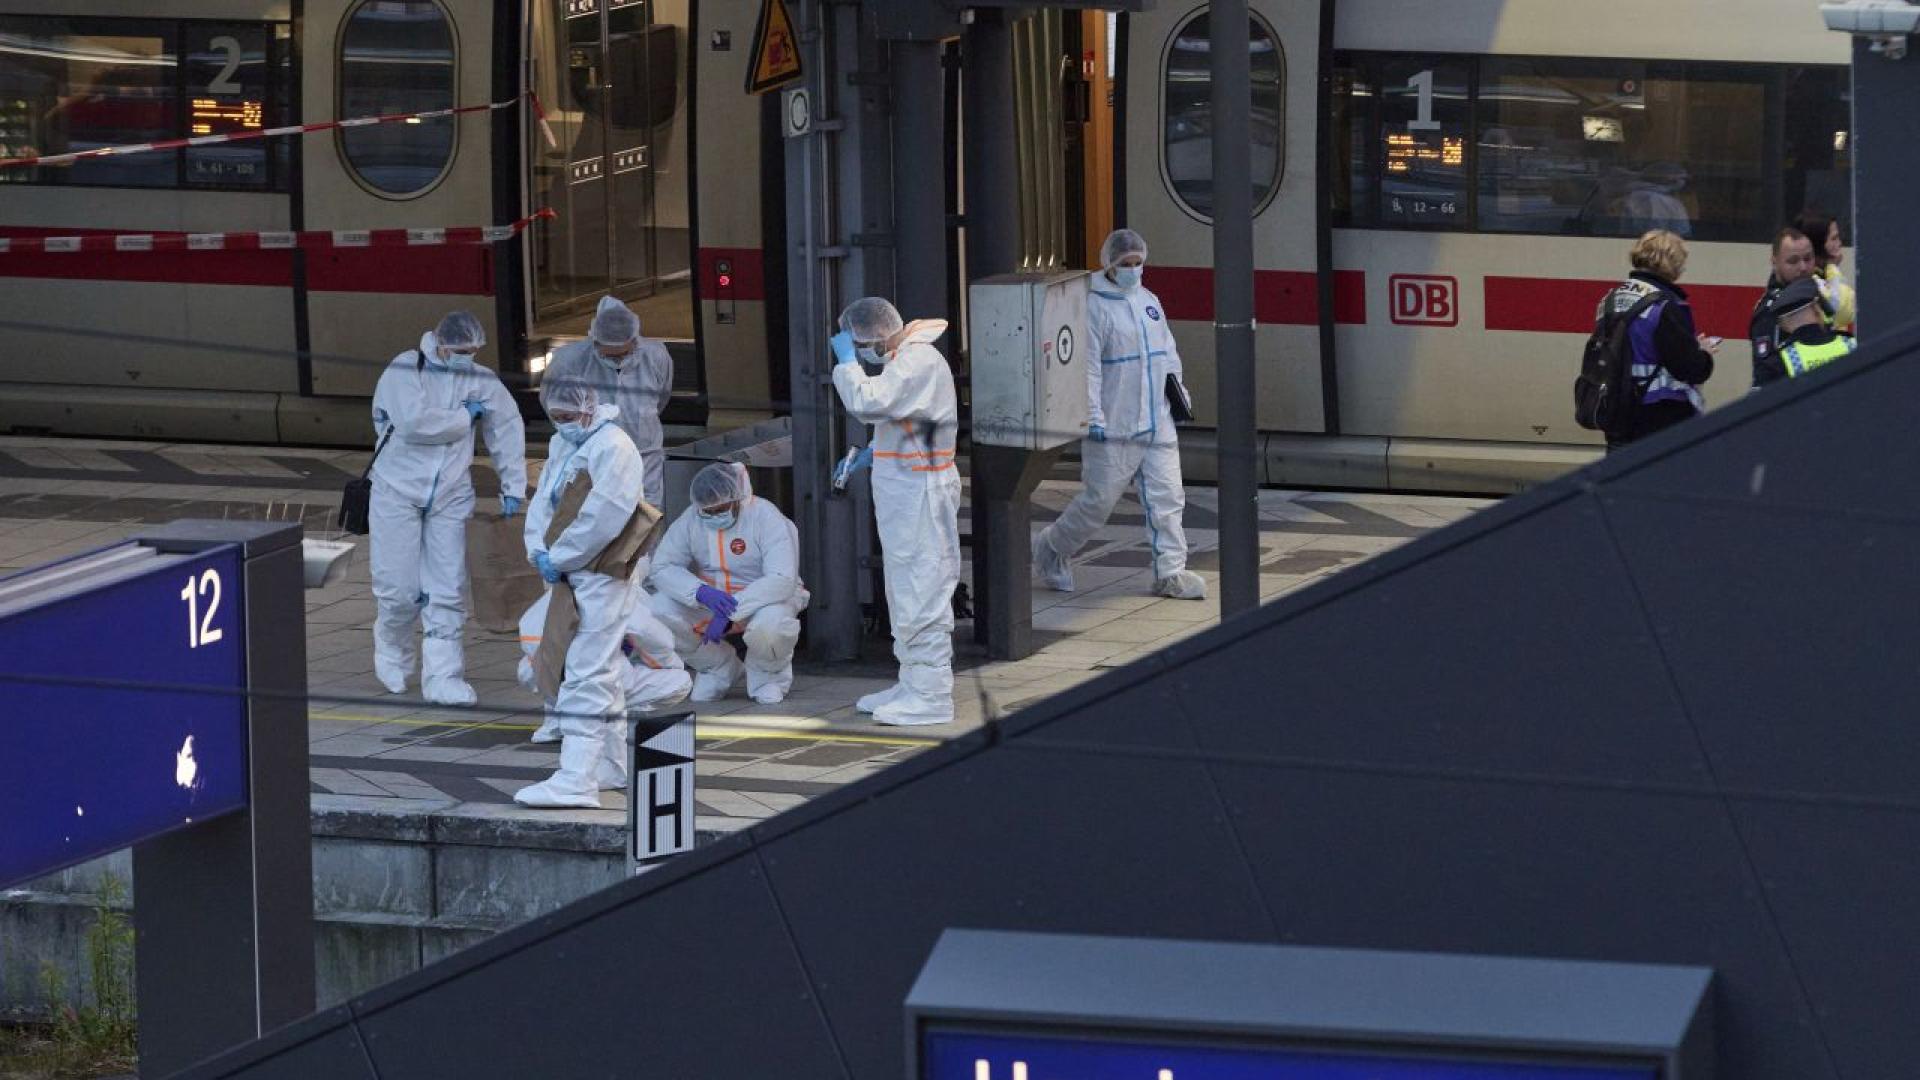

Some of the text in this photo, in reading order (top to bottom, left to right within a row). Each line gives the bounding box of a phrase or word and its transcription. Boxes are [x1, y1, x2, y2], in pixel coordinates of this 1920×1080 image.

[209, 35, 241, 94] 2
[1407, 70, 1441, 130] 1
[1414, 201, 1427, 213] 12
[1440, 202, 1456, 214] 66
[1398, 282, 1450, 319] DB
[181, 567, 223, 649] 12
[648, 767, 683, 853] H
